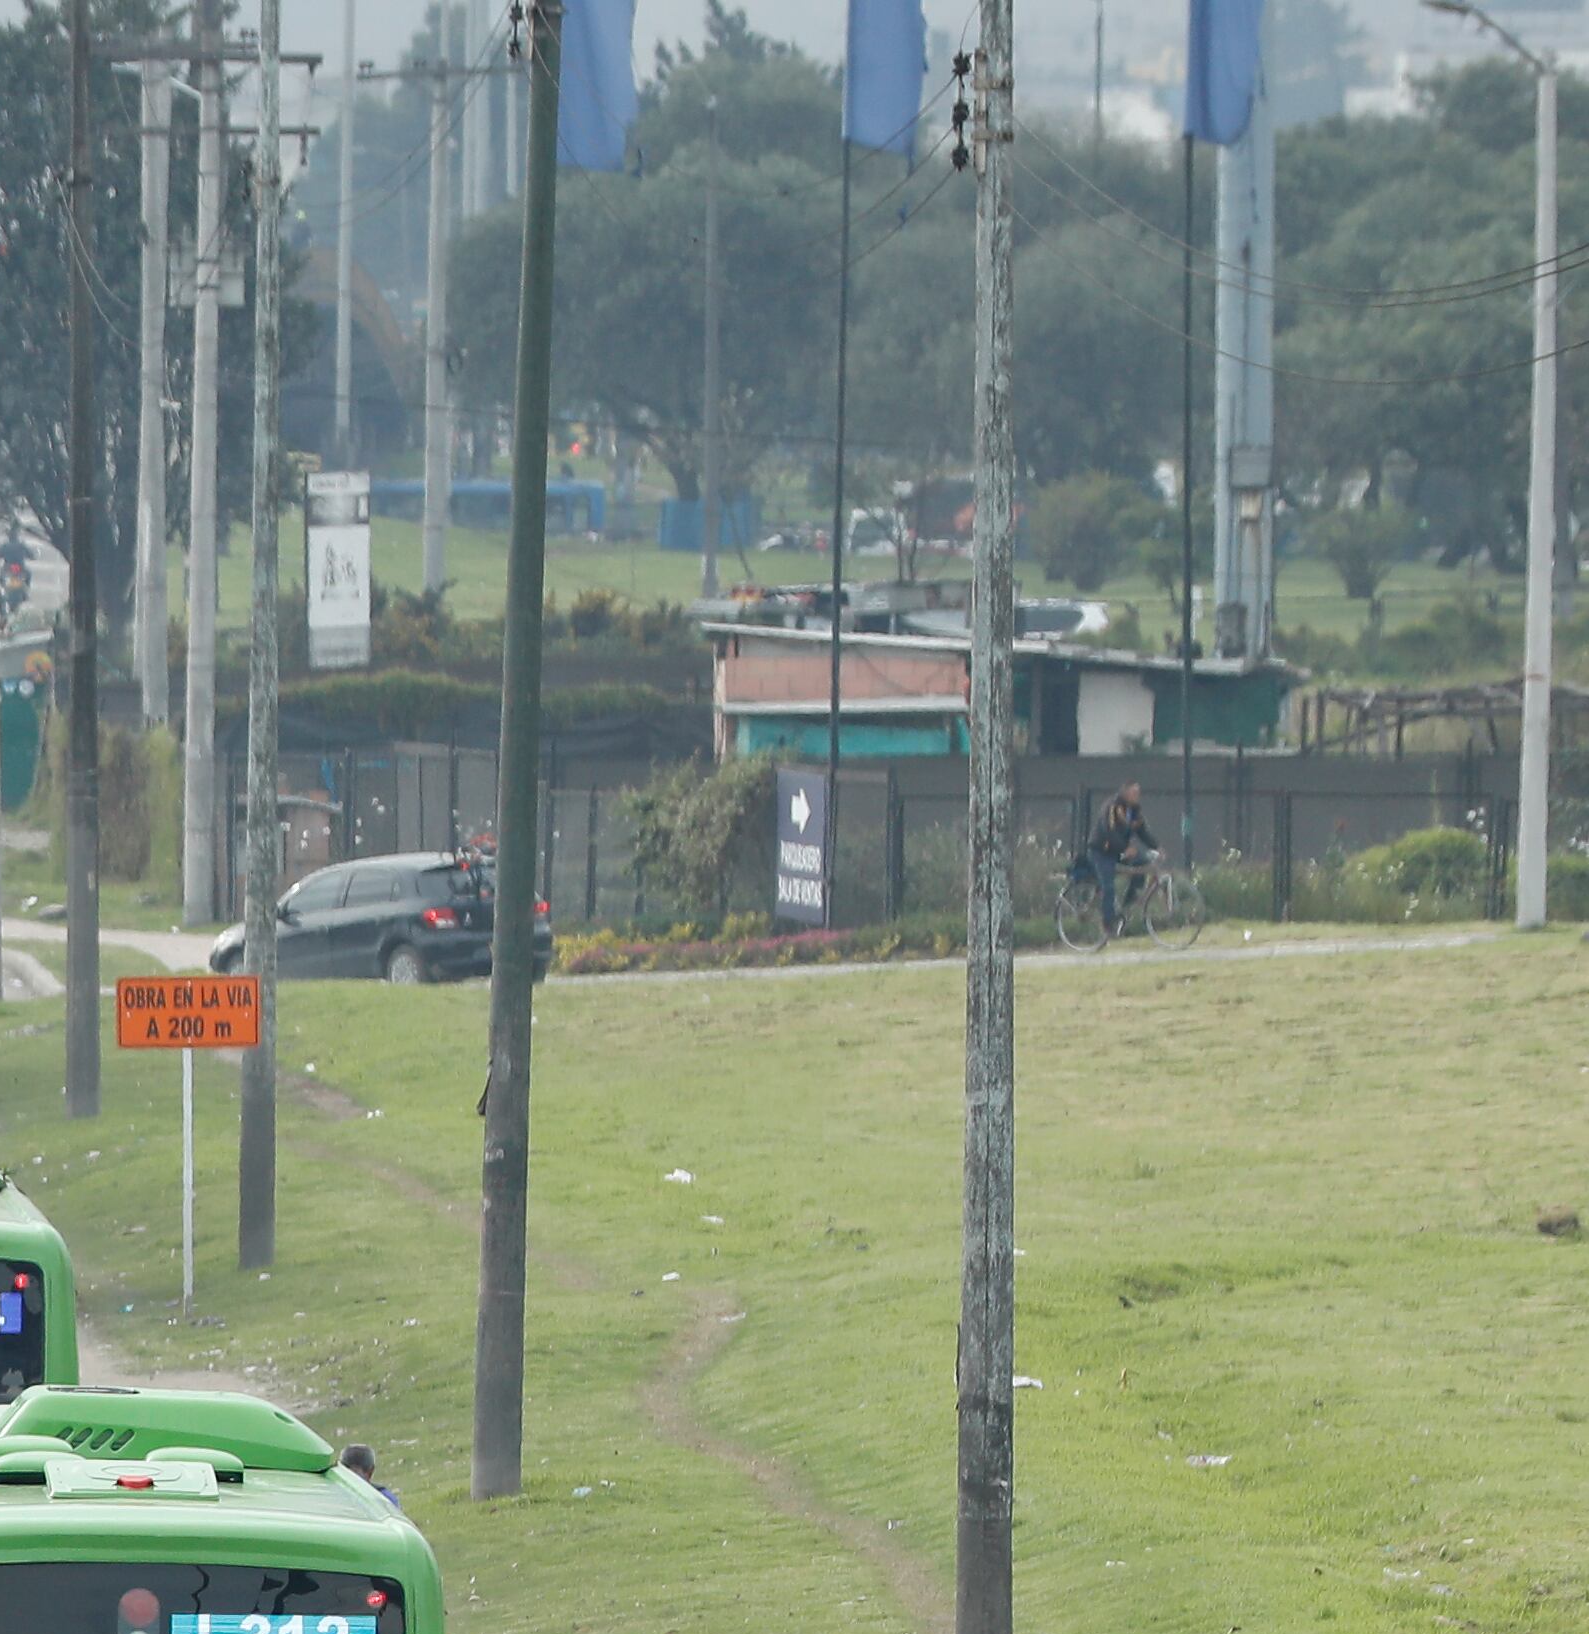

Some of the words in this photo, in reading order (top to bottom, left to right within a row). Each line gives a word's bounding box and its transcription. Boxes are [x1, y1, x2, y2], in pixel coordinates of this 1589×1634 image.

[124, 986, 167, 1009] OBRA
[173, 985, 194, 1009] EN
[200, 985, 220, 1008] LA
[227, 984, 252, 1008] VIA
[147, 1017, 160, 1039] A
[168, 1016, 205, 1039] 200
[214, 1019, 232, 1038] m
